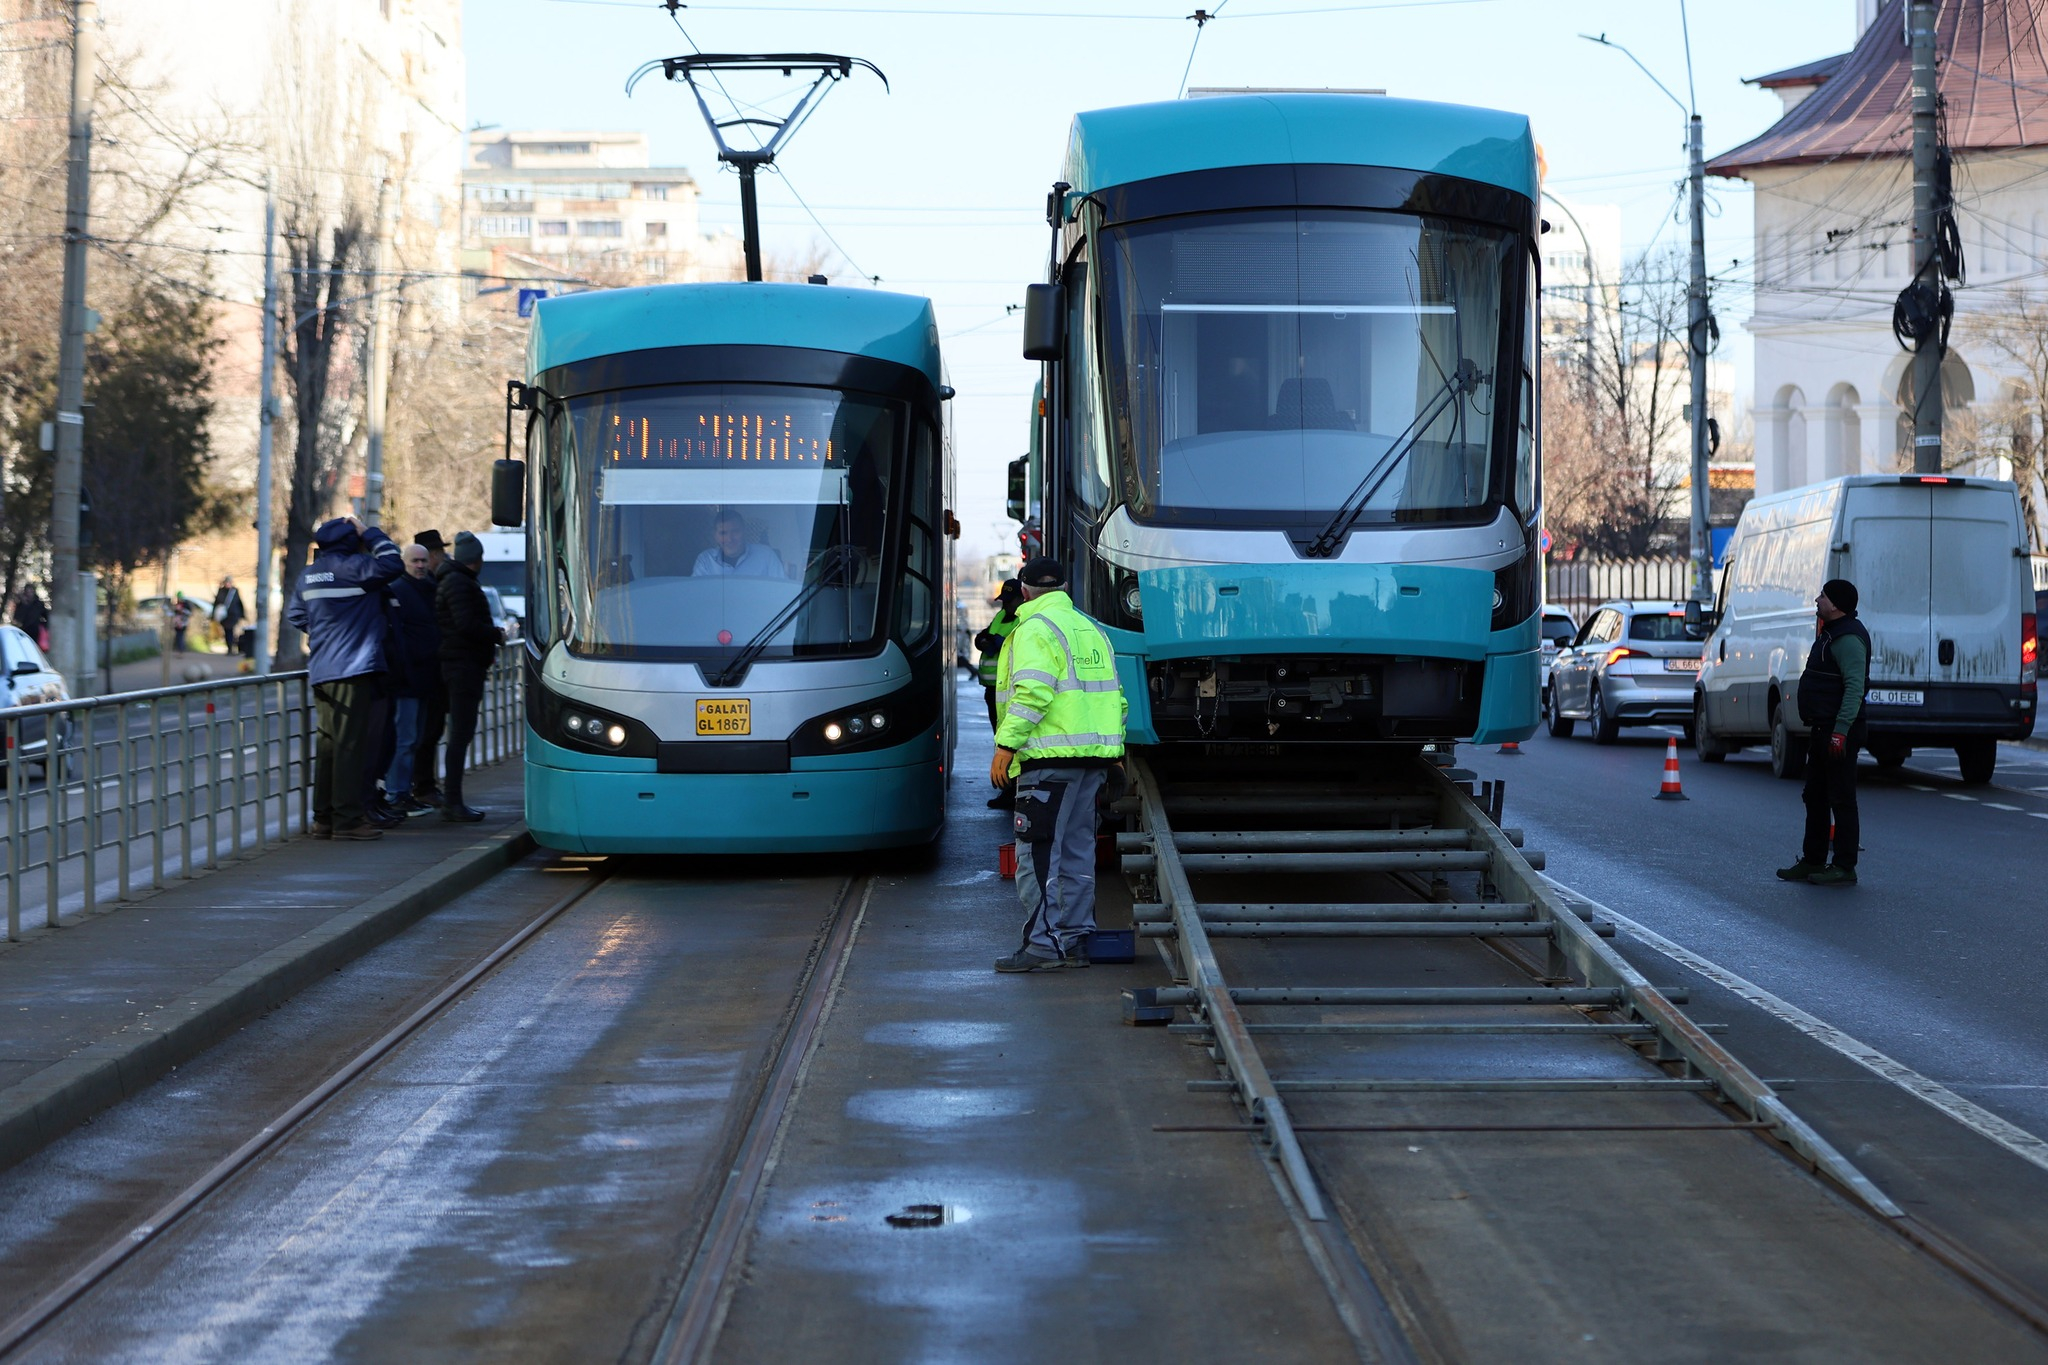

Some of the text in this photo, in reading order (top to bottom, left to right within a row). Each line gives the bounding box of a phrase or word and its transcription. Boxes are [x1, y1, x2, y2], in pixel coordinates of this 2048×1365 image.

[1669, 660, 1680, 669] GL
[1871, 691, 1884, 702] GL
[706, 704, 748, 714] GALATI
[699, 719, 747, 731] GL 1867
